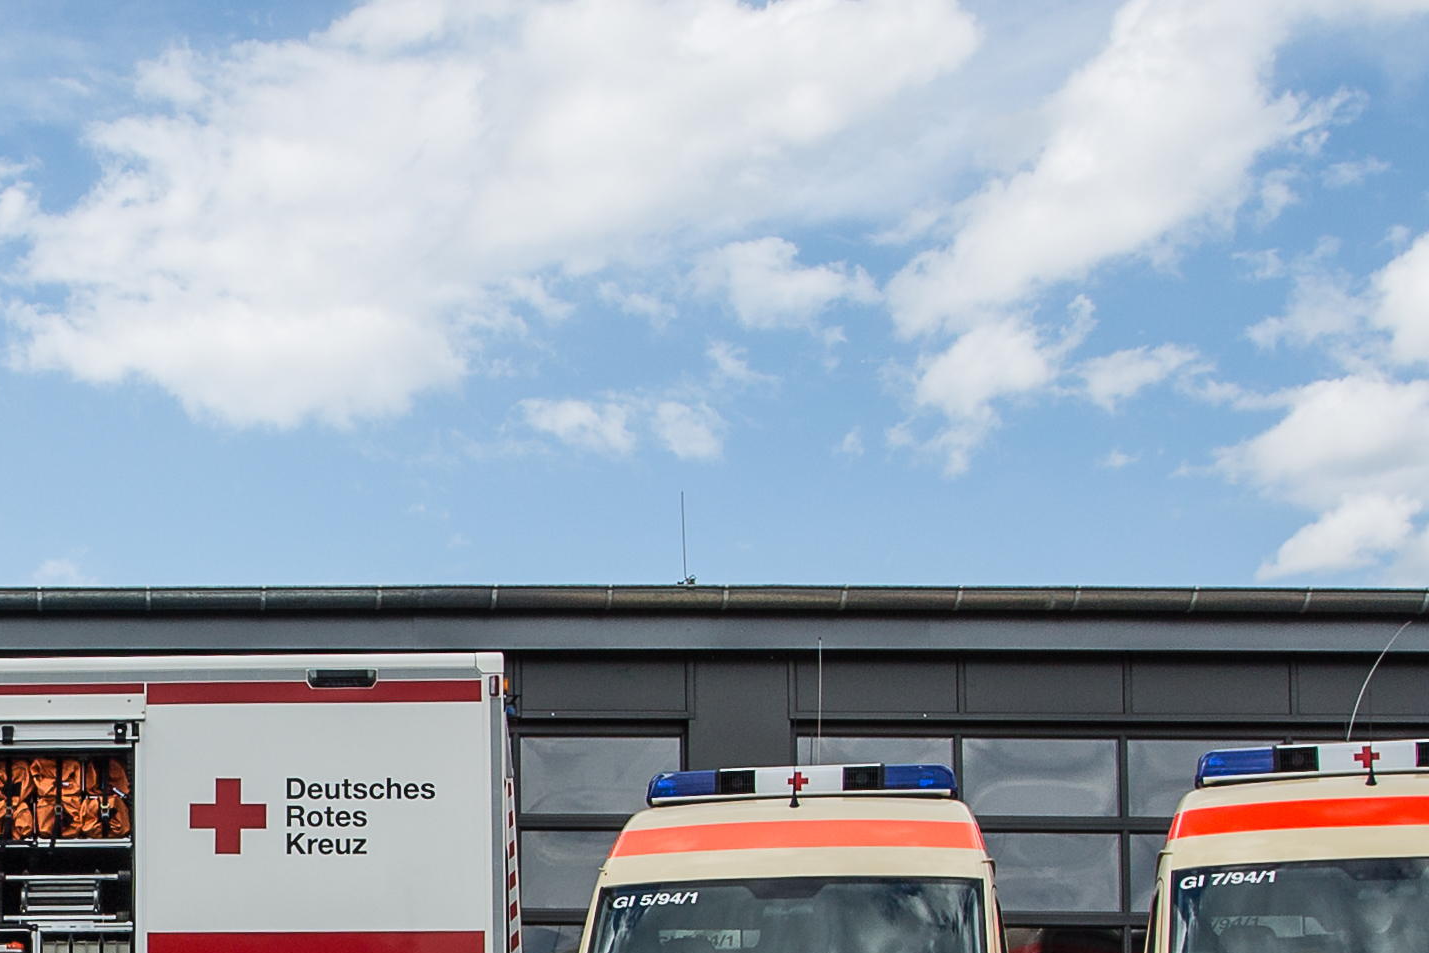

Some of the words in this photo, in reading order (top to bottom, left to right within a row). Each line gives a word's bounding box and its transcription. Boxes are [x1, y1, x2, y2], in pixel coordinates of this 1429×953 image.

[286, 778, 436, 799] Deutsches
[286, 805, 367, 827] Rotes
[286, 833, 367, 854] Kreuz
[1180, 875, 1205, 889] GI
[1211, 870, 1276, 886] 7/94/1
[613, 896, 635, 908] GI
[640, 892, 698, 906] 5/94/1
